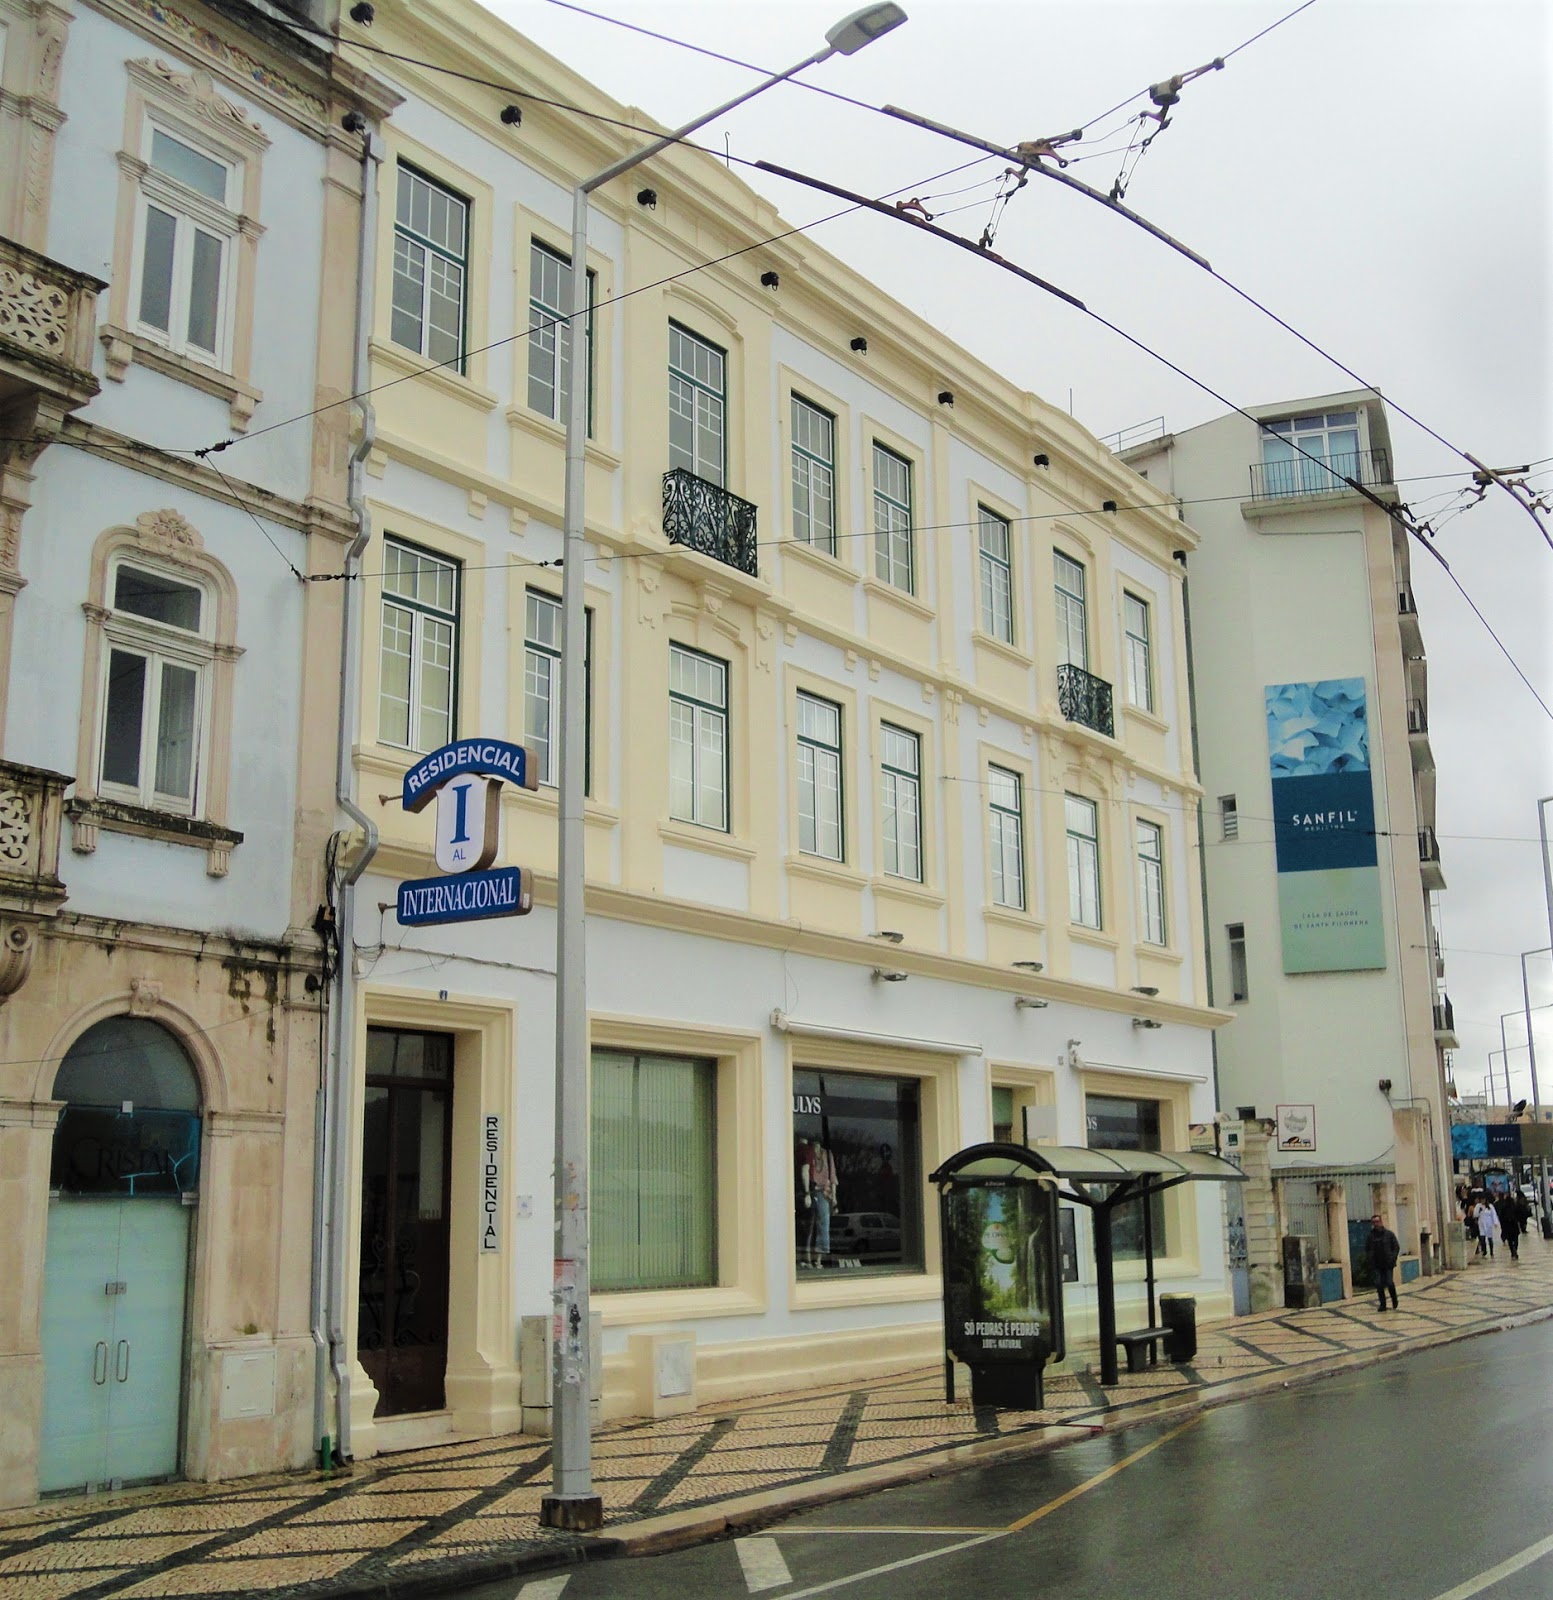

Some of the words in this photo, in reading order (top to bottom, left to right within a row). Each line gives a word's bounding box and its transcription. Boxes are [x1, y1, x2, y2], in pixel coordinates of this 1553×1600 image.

[407, 745, 521, 793] RESIDENCIAL
[450, 784, 472, 844] I
[1292, 810, 1356, 826] SANFIL
[452, 849, 466, 861] AL
[402, 876, 516, 917] INTERNACIONAL
[484, 1116, 498, 1249] RESIDENCIAL
[964, 1319, 975, 1336] SÓ
[976, 1321, 1003, 1336] PEDRAS
[1004, 1319, 1010, 1336] É
[1010, 1321, 1040, 1337] PEDRAS
